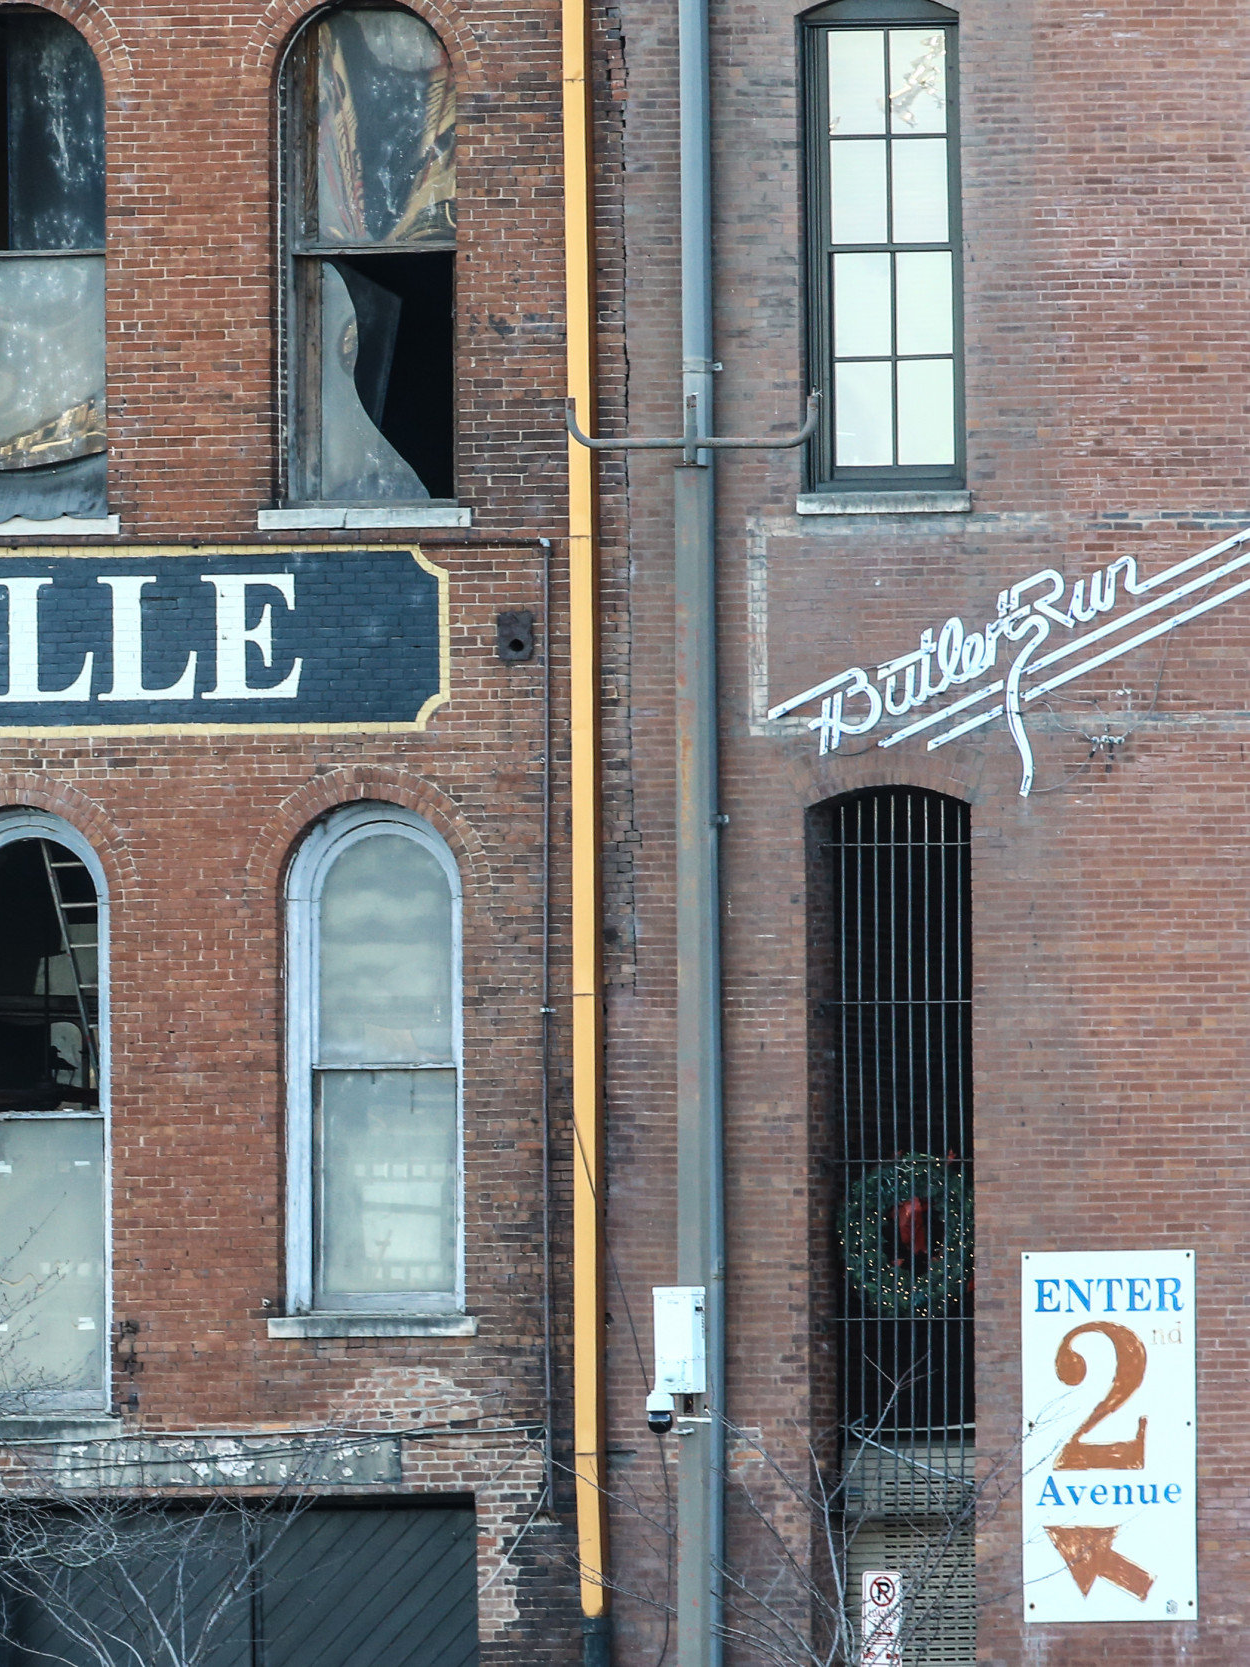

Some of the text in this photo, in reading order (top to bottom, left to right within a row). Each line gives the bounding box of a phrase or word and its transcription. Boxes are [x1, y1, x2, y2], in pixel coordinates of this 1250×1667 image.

[1007, 555, 1143, 630] Run
[1034, 1277, 1185, 1313] ENTER
[1036, 1475, 1183, 1506] Avenue
